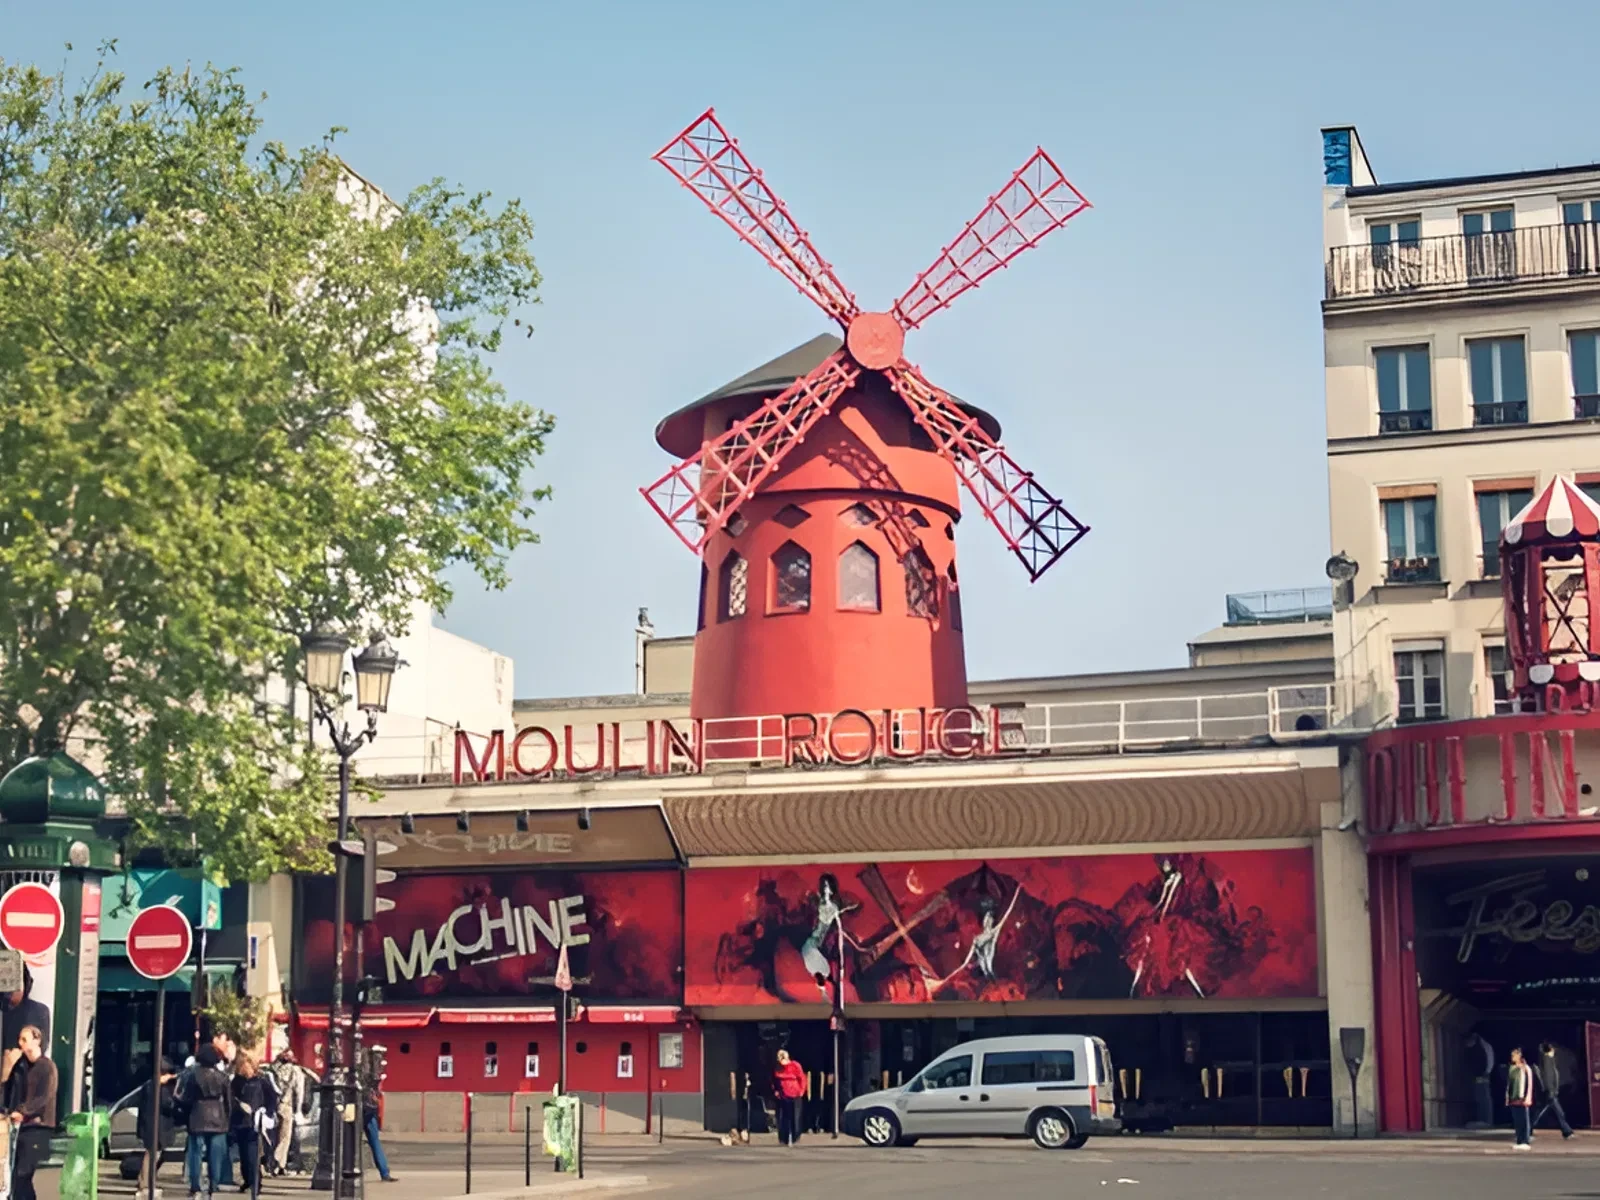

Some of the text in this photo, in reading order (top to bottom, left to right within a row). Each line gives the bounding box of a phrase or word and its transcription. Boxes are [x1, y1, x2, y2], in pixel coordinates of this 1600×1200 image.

[452, 701, 1026, 785] MOULIN ROUGE
[383, 894, 591, 984] MACHINE
